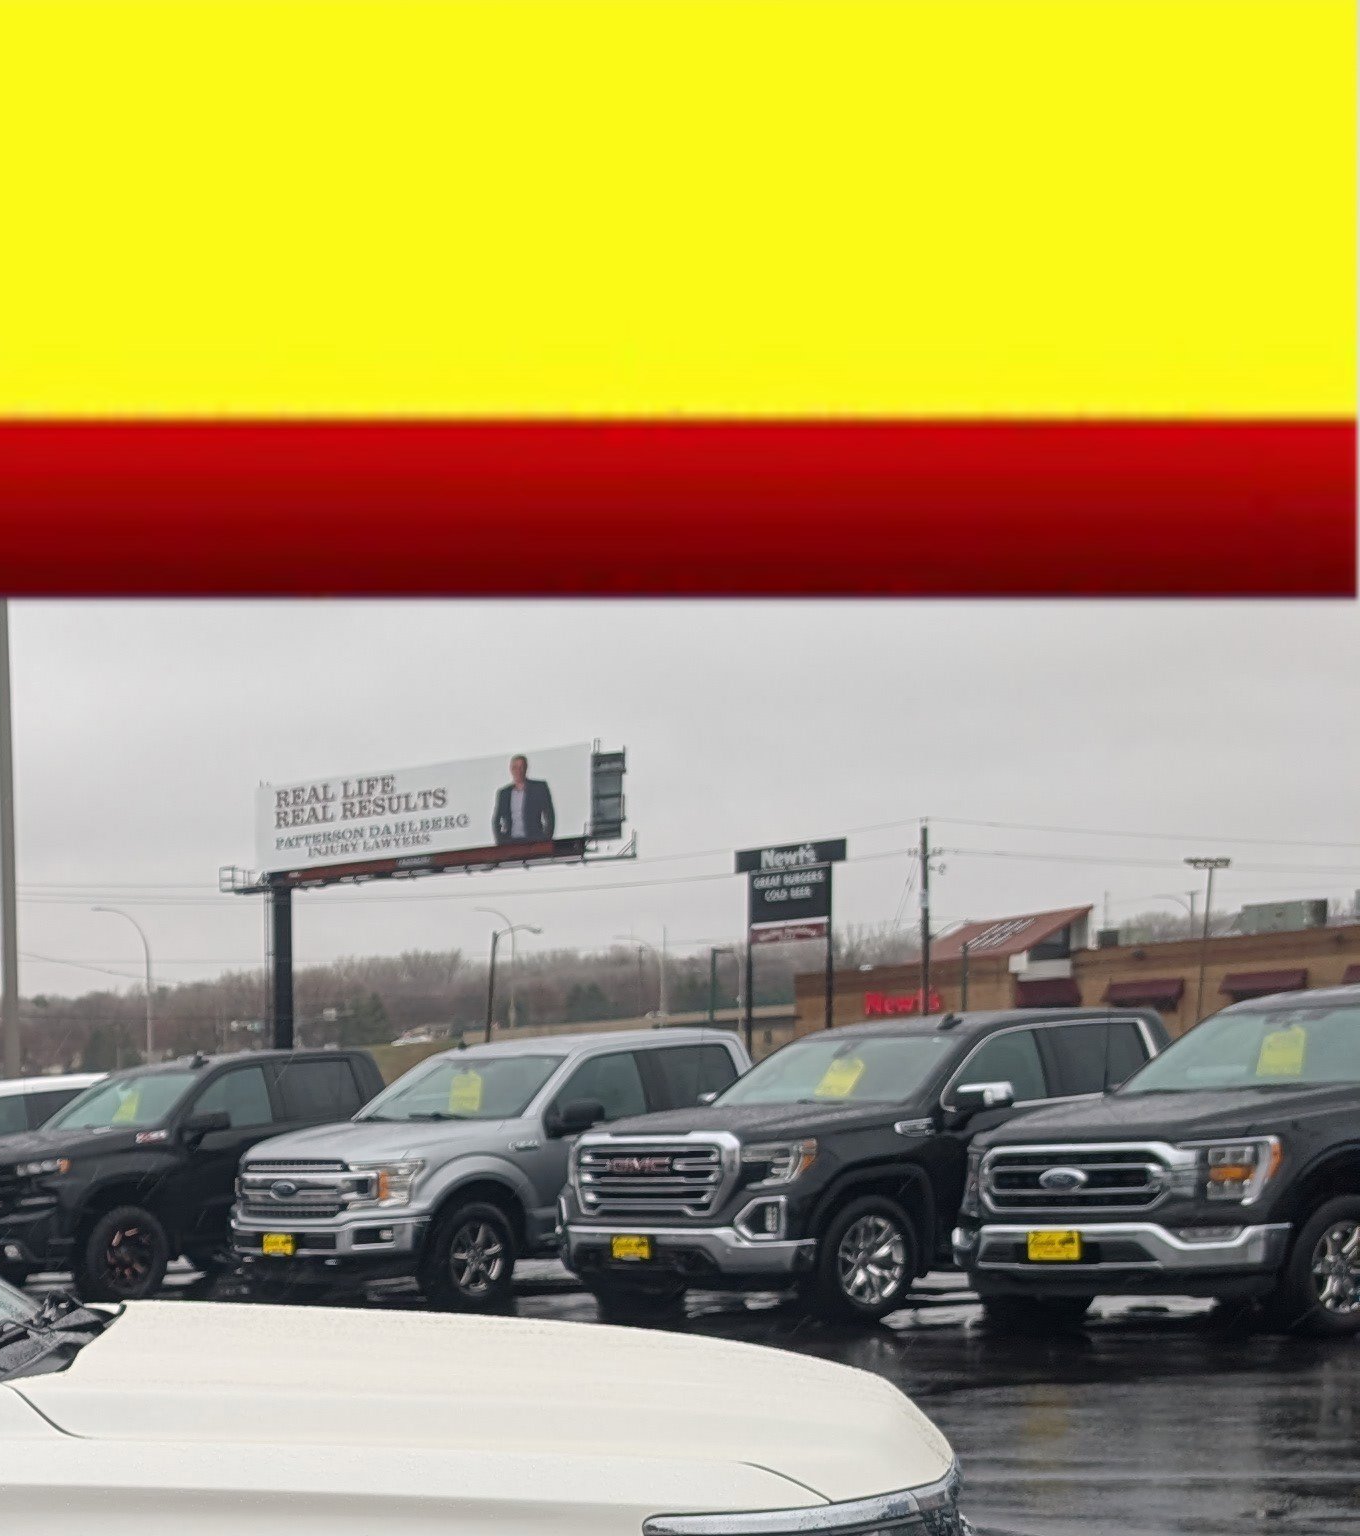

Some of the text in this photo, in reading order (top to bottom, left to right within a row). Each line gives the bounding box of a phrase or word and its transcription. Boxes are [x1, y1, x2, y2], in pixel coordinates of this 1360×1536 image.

[275, 774, 395, 807] REAL LIFE
[275, 786, 448, 829] REAL RESULTS
[276, 813, 470, 849] PATTERSON DAHLBERG
[308, 834, 431, 857] INJURY LAWYERS
[760, 844, 816, 869] Newt's
[606, 1157, 671, 1173] GMC
